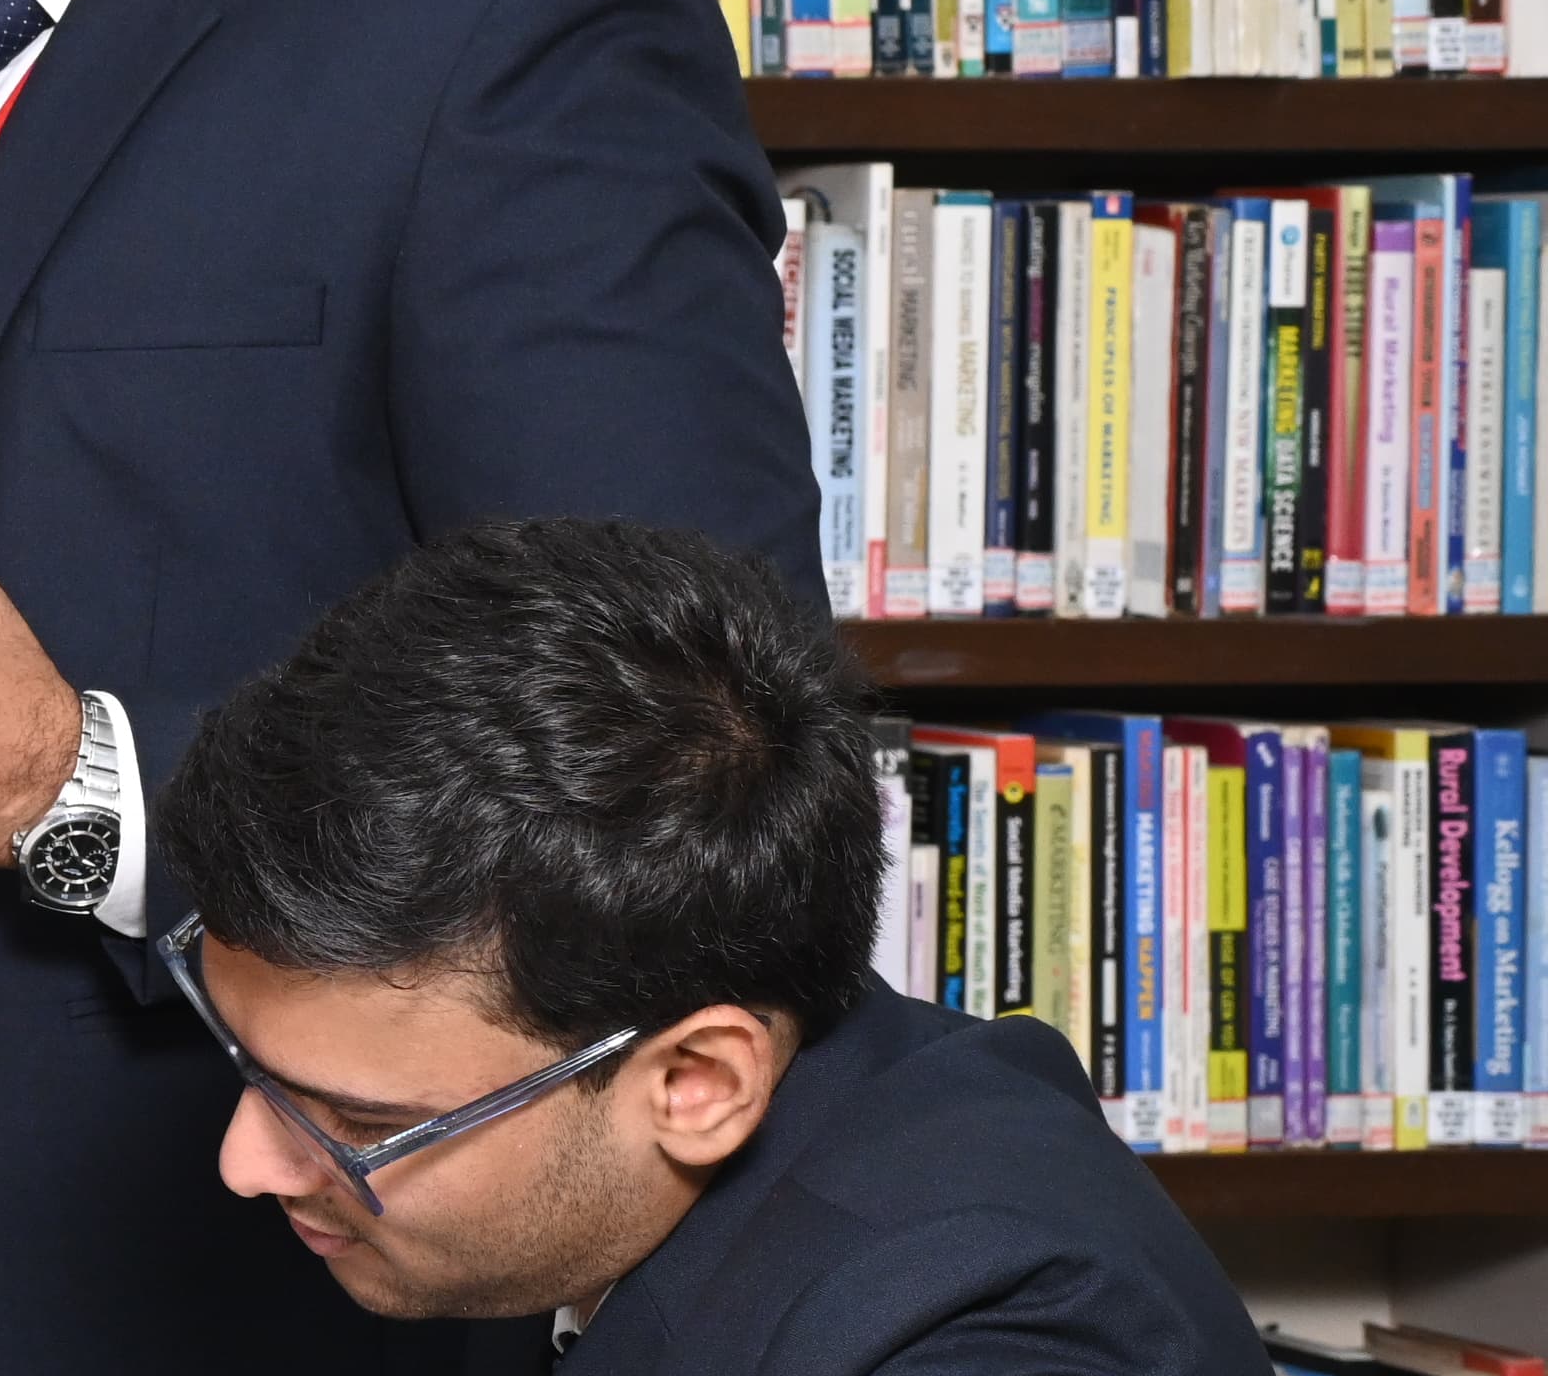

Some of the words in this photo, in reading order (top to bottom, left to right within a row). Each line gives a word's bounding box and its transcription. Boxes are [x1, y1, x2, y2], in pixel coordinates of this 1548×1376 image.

[832, 248, 855, 312] SOCIAL
[832, 318, 855, 368] MEDIA
[1277, 326, 1297, 432] MARKETING
[832, 377, 855, 478] MARKETING
[1275, 439, 1297, 484] DATA
[1272, 491, 1294, 572] SCIENCE
[1434, 749, 1469, 815] Rural
[1434, 820, 1469, 980] Development
[1485, 819, 1518, 913] Kellogg
[1496, 918, 1510, 943] on
[1486, 948, 1516, 1075] Marketing
